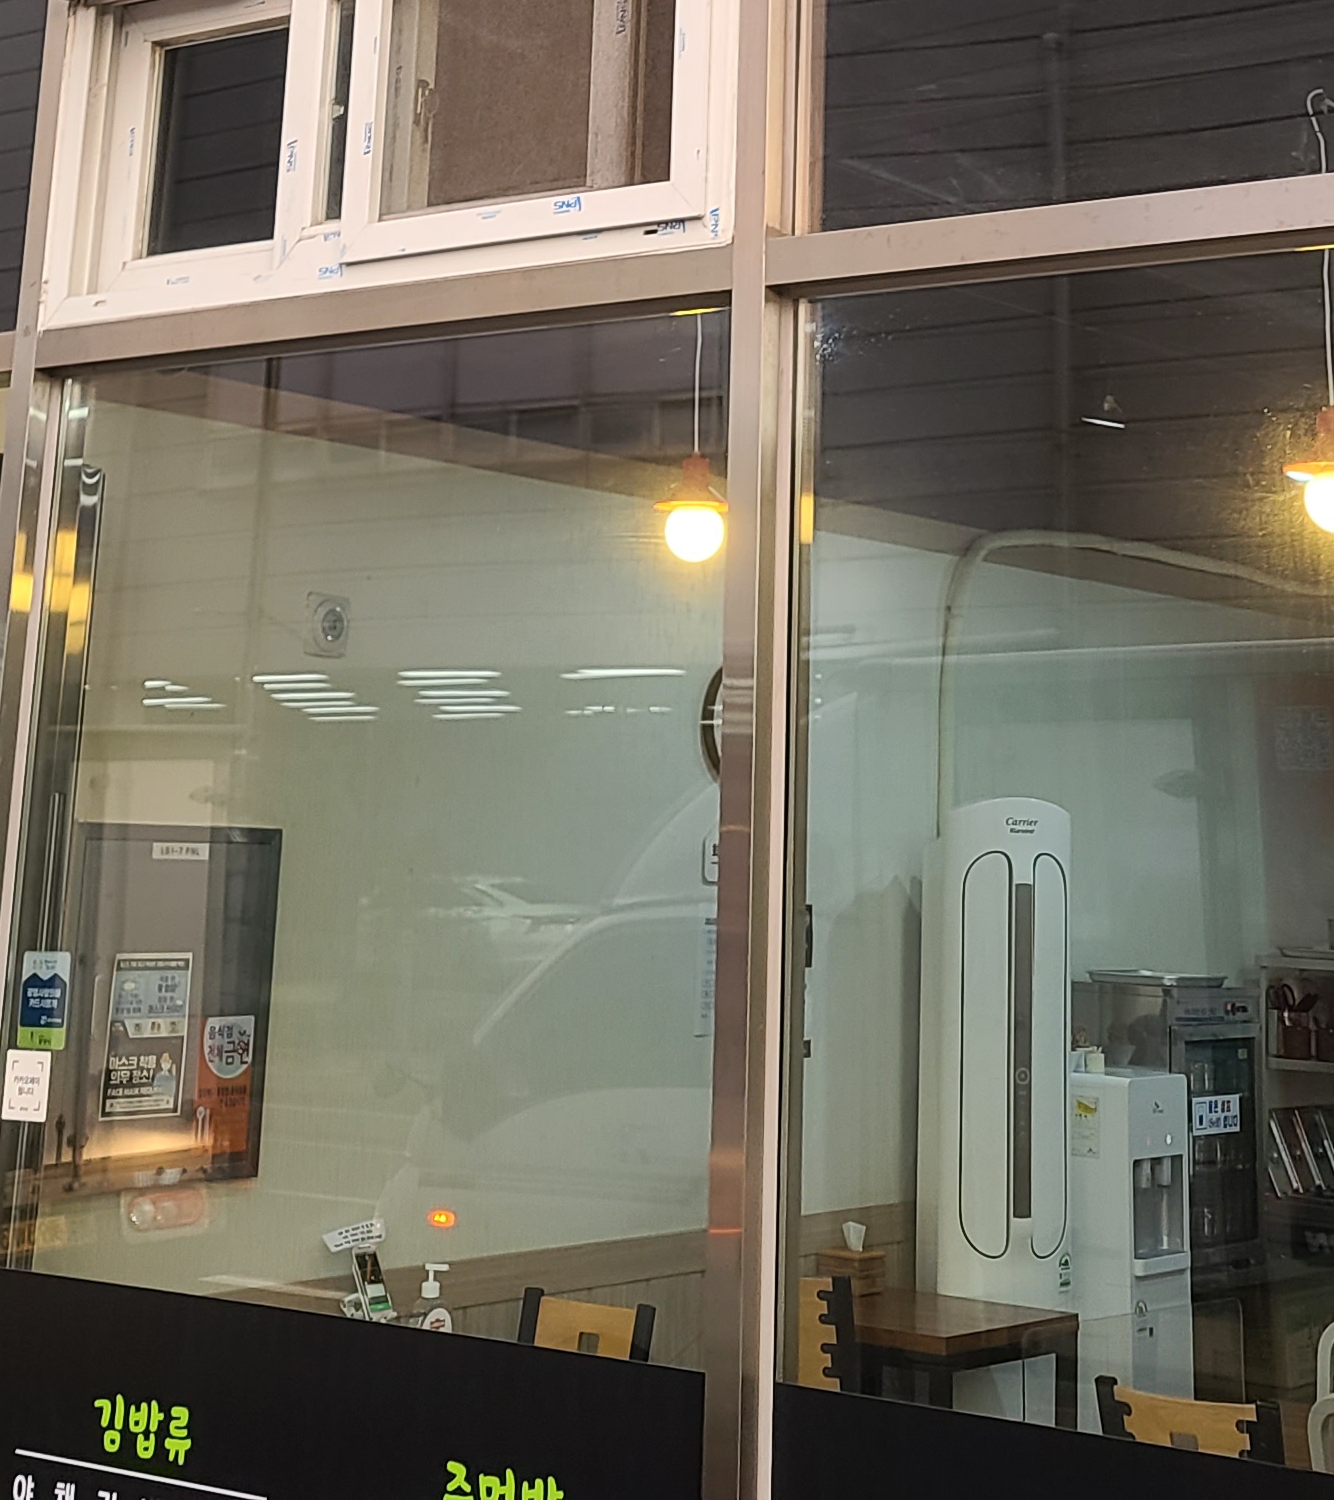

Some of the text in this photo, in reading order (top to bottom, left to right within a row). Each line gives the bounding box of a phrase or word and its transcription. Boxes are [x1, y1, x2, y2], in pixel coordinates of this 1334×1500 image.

[1005, 816, 1039, 827] Carrier
[208, 1024, 234, 1041] 음식점
[109, 1055, 138, 1071] 마스크
[109, 1071, 131, 1085] 의무
[93, 1393, 192, 1466] 김밥류
